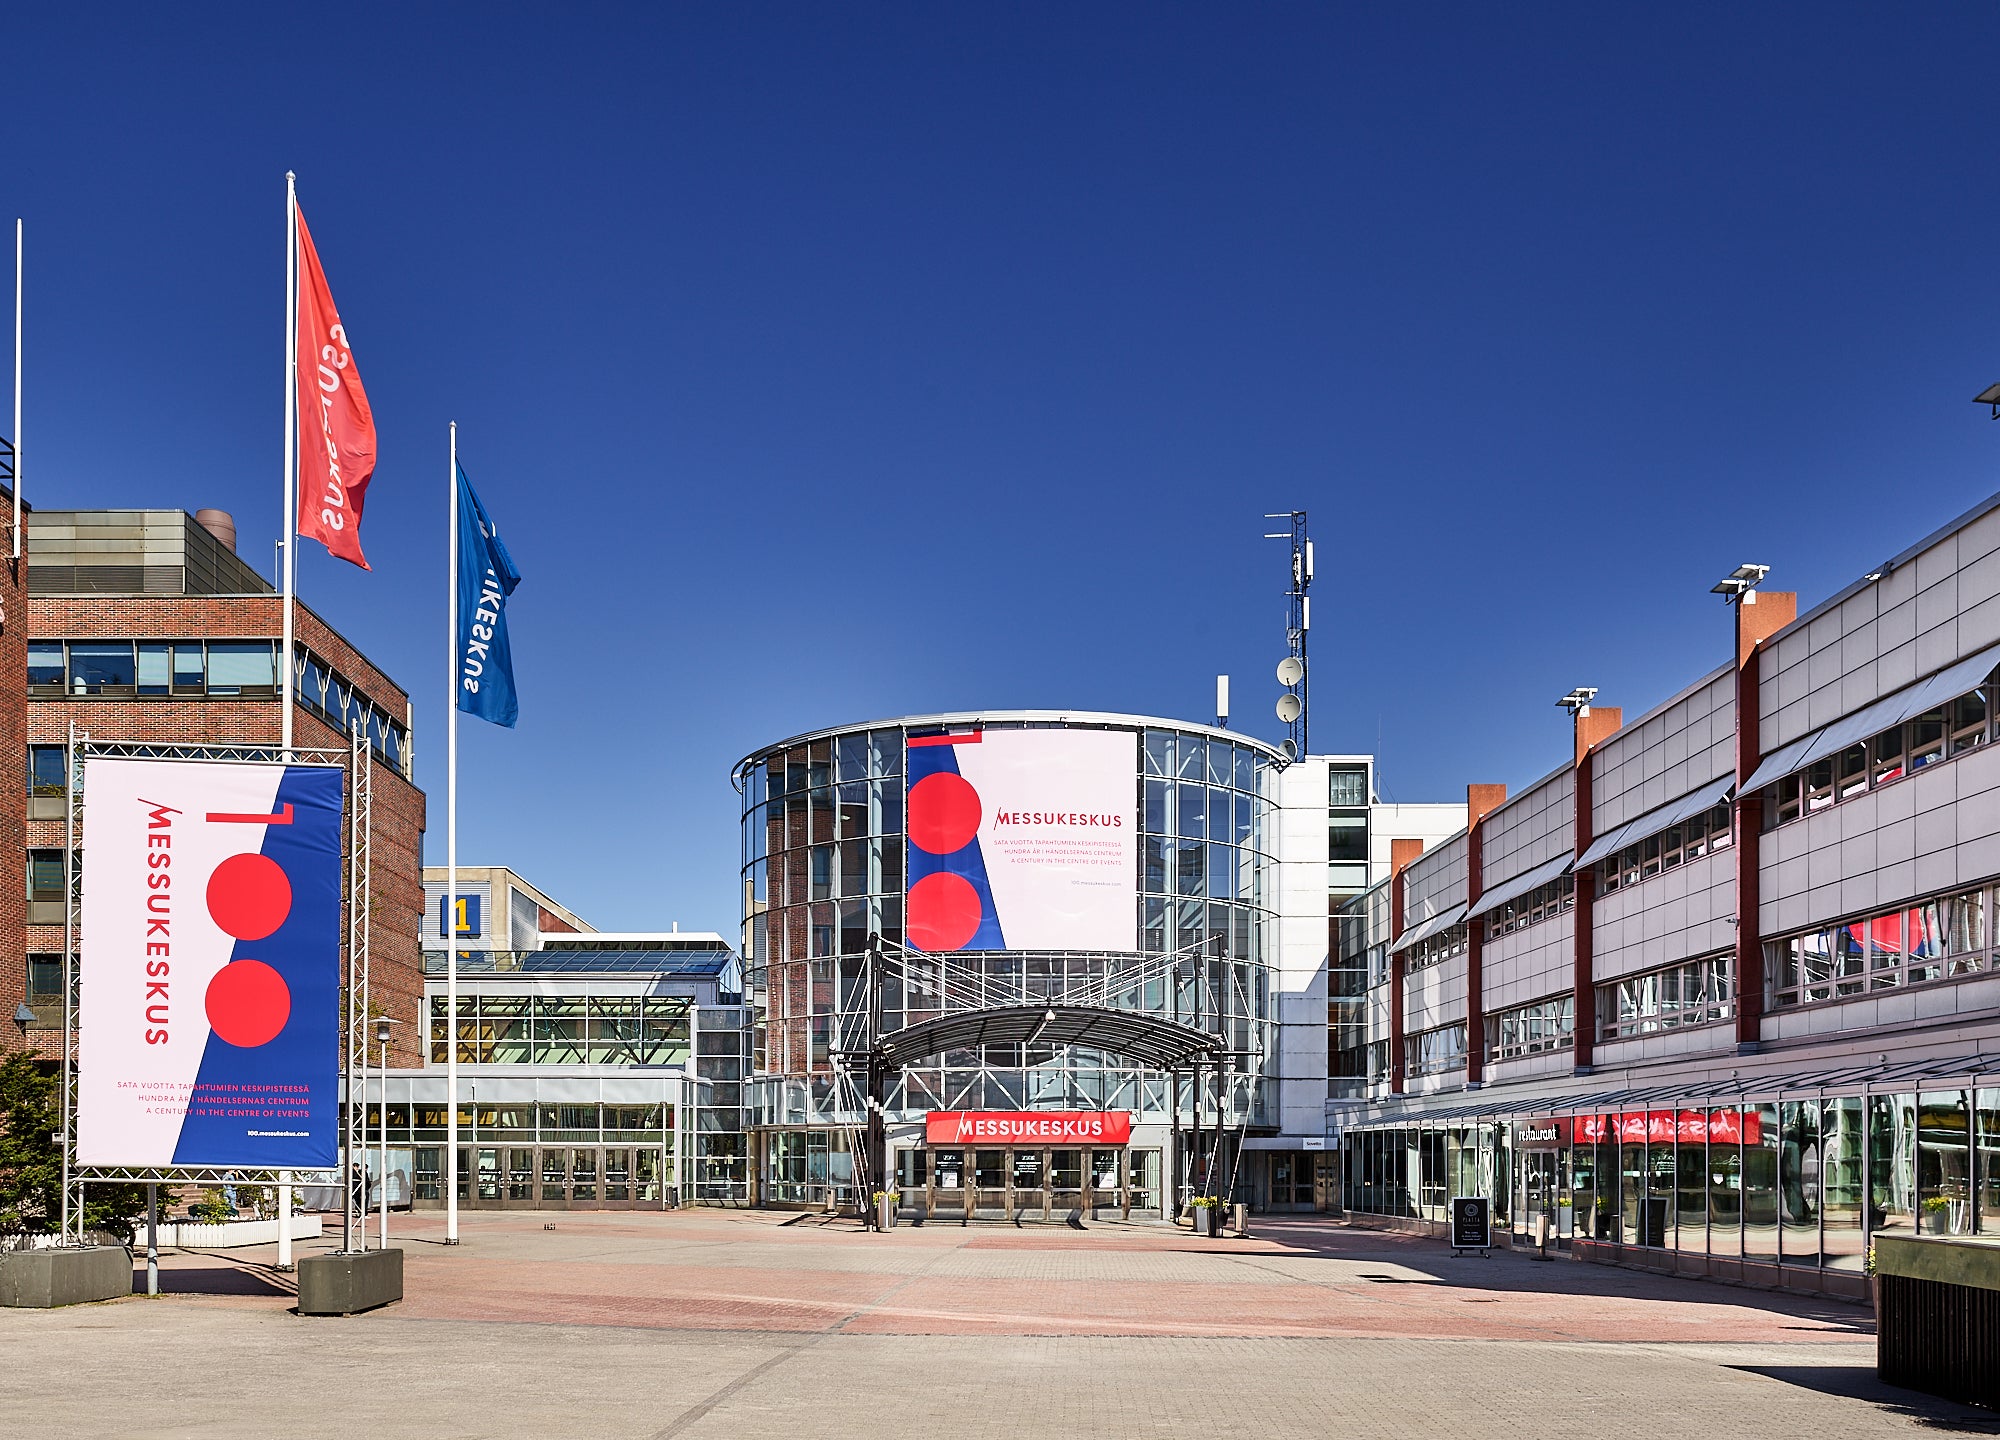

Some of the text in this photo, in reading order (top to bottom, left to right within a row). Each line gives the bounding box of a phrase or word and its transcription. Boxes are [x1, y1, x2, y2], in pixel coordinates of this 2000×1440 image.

[993, 807, 1122, 831] MESSUKESKUS
[137, 798, 183, 1045] MESSUKESKUS
[455, 898, 471, 932] 1
[197, 1096, 265, 1104] HÄNDELSERNAS
[954, 1112, 1102, 1143] MESSUKESKUS
[1518, 1123, 1557, 1141] restaurant
